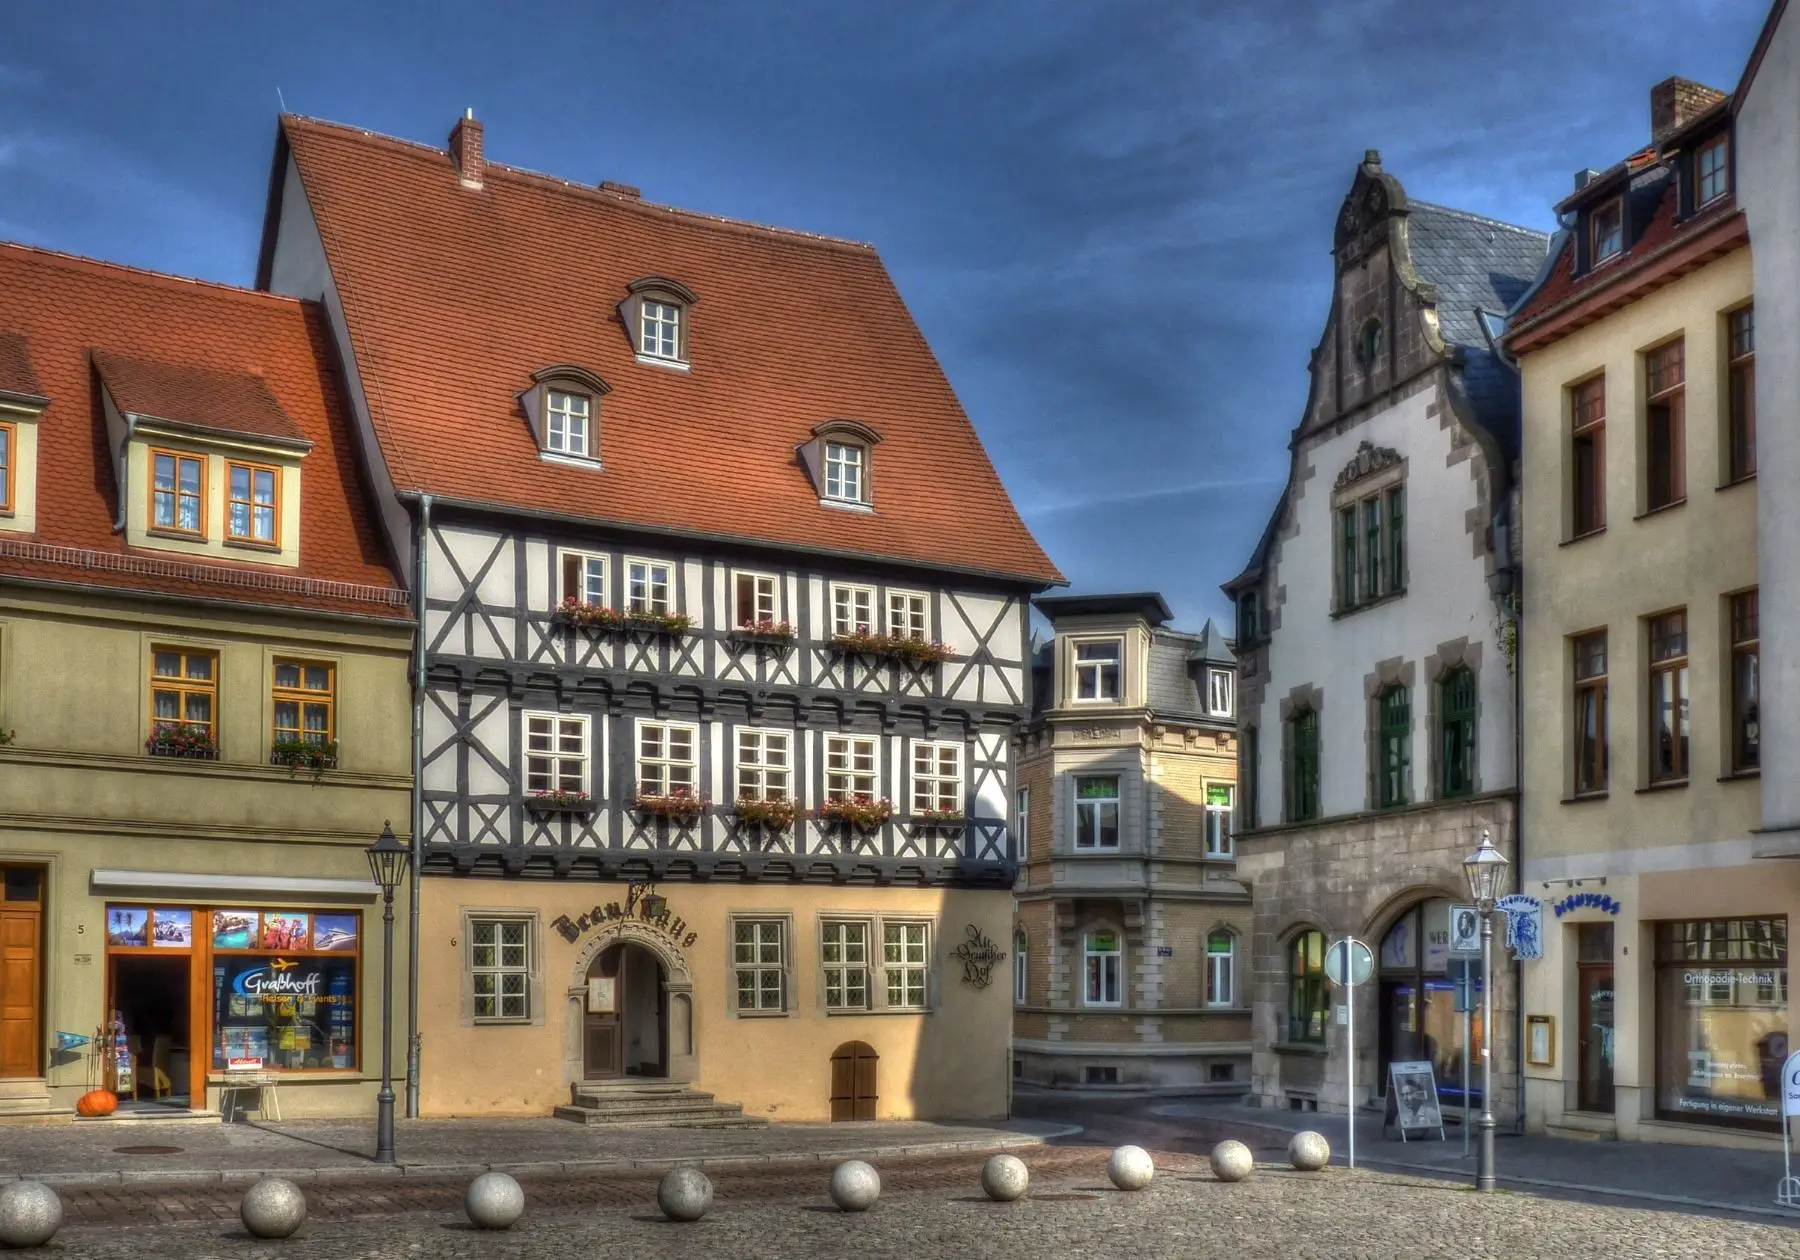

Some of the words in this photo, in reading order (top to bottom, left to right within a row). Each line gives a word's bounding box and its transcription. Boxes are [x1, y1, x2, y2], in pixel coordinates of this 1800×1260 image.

[78, 924, 84, 934] 5
[450, 937, 457, 947] 6
[244, 972, 320, 994] Graßhoff
[1684, 971, 1773, 985] Orthopädie-Technik
[1679, 1098, 1709, 1111] Fertigung
[1718, 1102, 1743, 1113] eigener
[1745, 1104, 1778, 1116] Werkstatt
